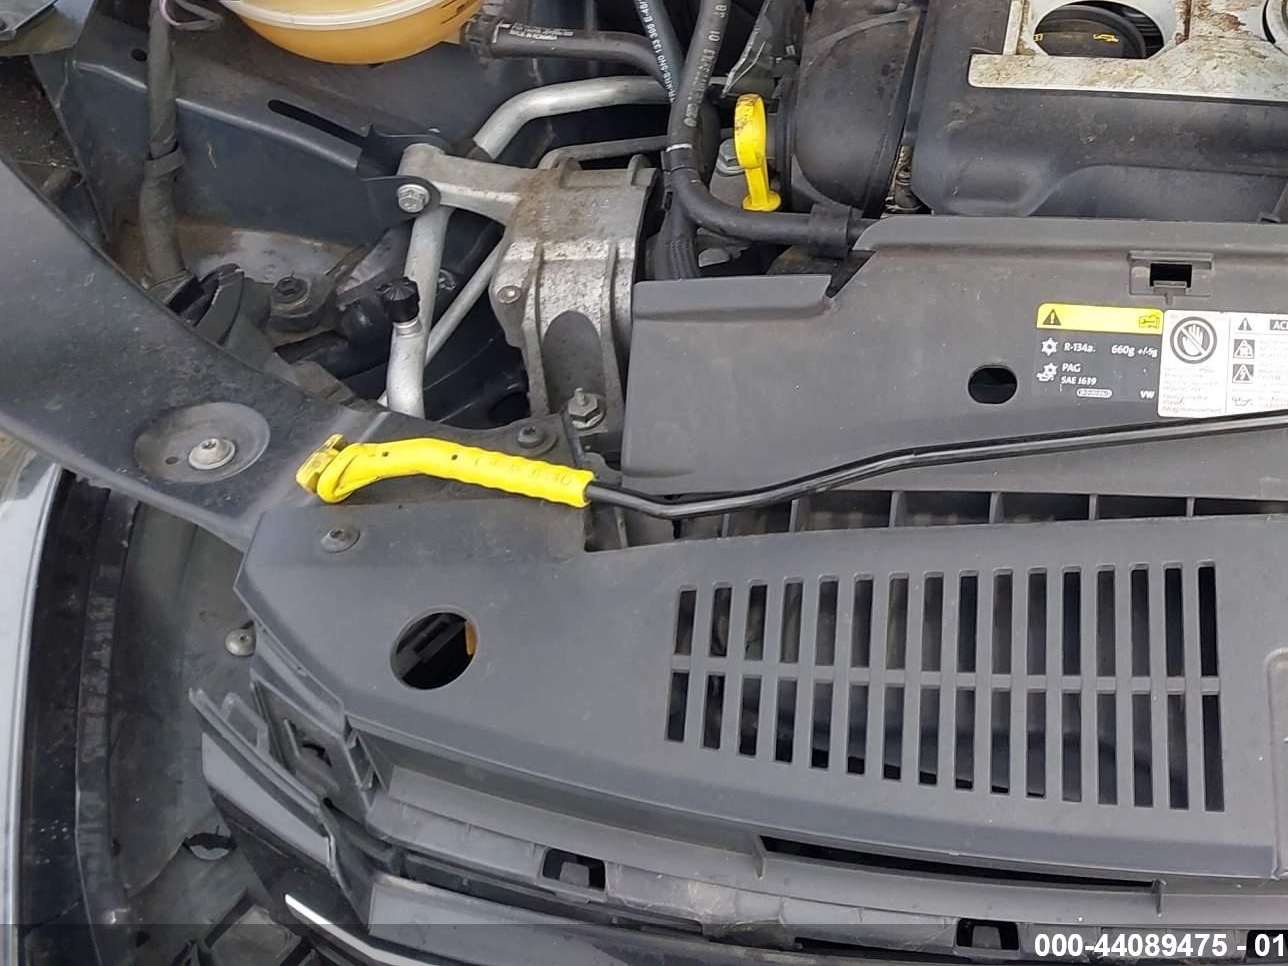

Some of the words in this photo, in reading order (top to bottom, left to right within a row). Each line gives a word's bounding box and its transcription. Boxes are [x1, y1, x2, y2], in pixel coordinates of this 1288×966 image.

[1111, 344, 1135, 357] 660g
[1062, 363, 1081, 373] PAG
[1060, 376, 1077, 385] SAE
[1140, 390, 1155, 400] VW
